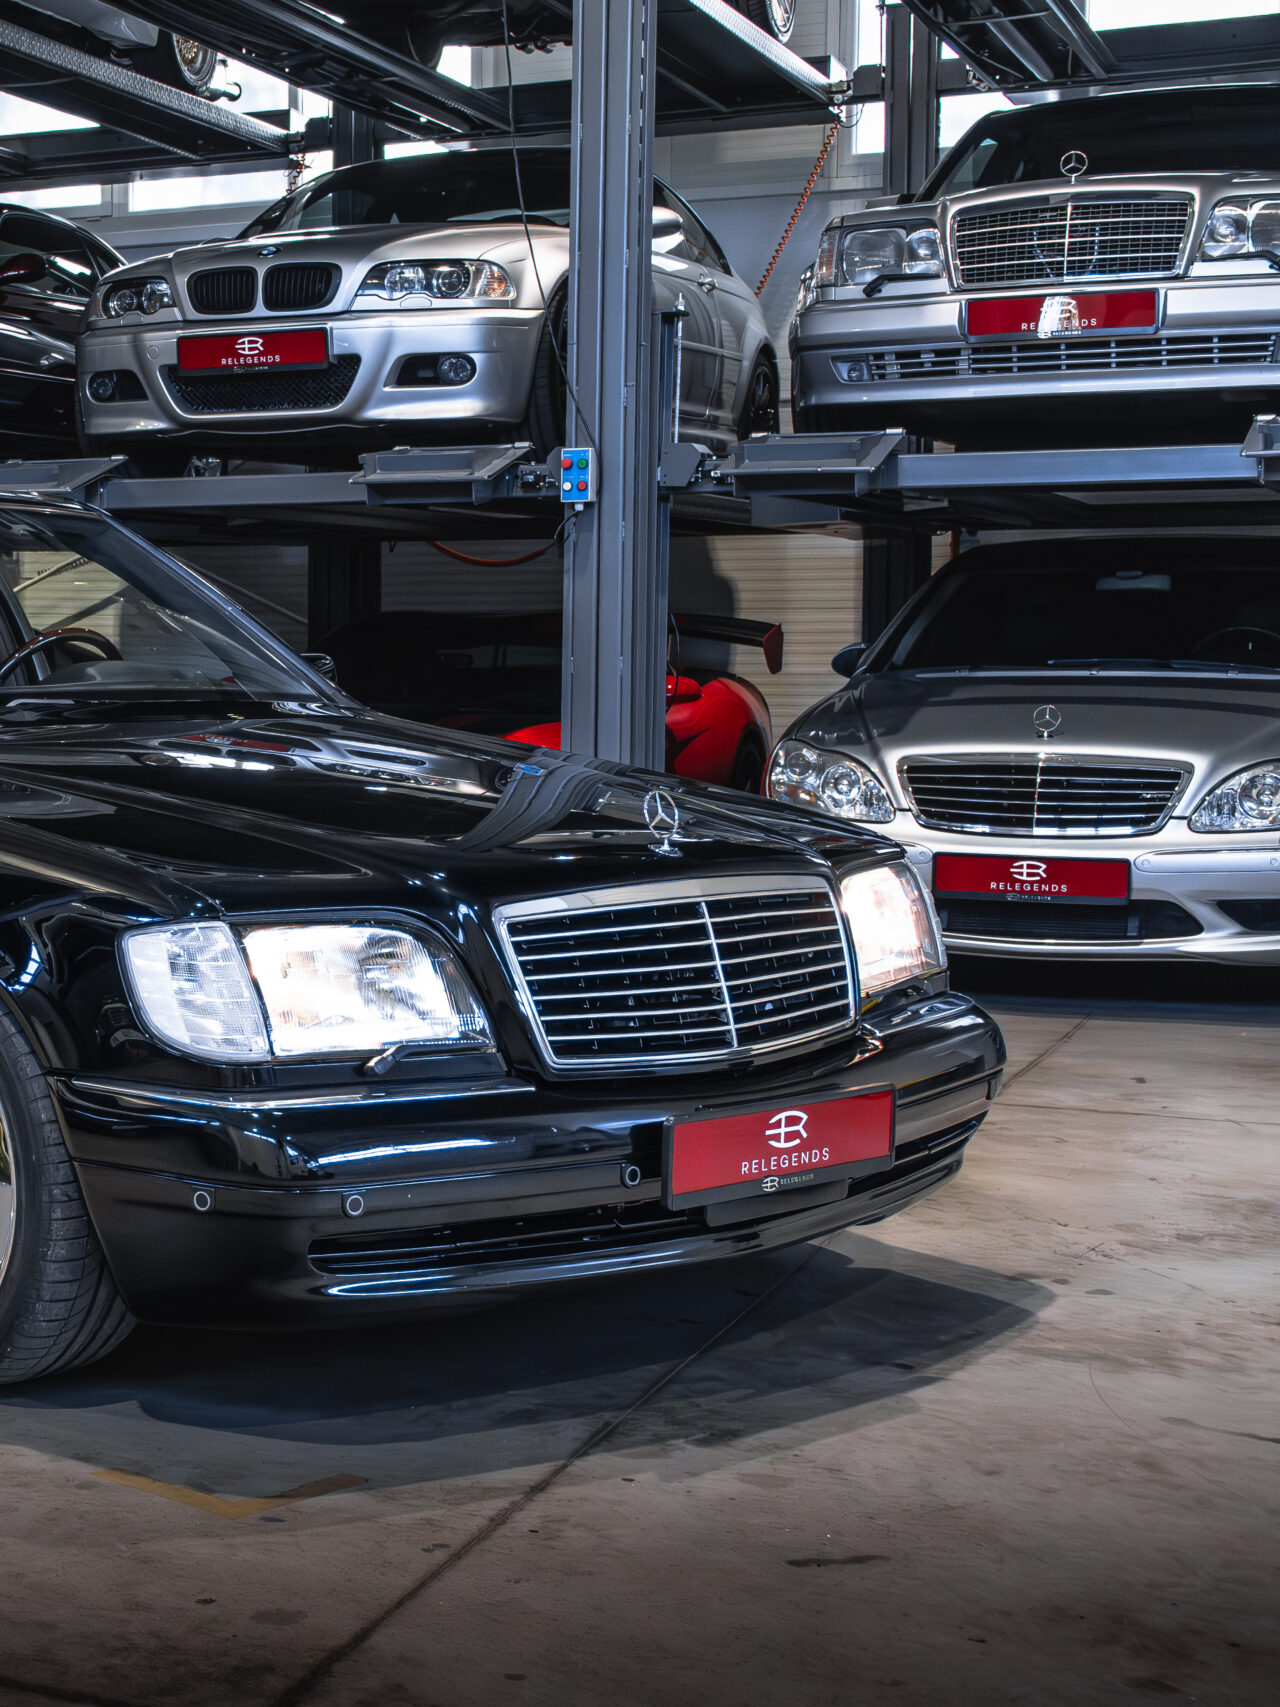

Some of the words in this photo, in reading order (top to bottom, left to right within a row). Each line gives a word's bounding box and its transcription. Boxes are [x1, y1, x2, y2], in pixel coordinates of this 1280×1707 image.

[221, 355, 281, 365] RELEGENDS
[990, 882, 1068, 892] RELEGENDS
[741, 1148, 830, 1175] RELEGENDS
